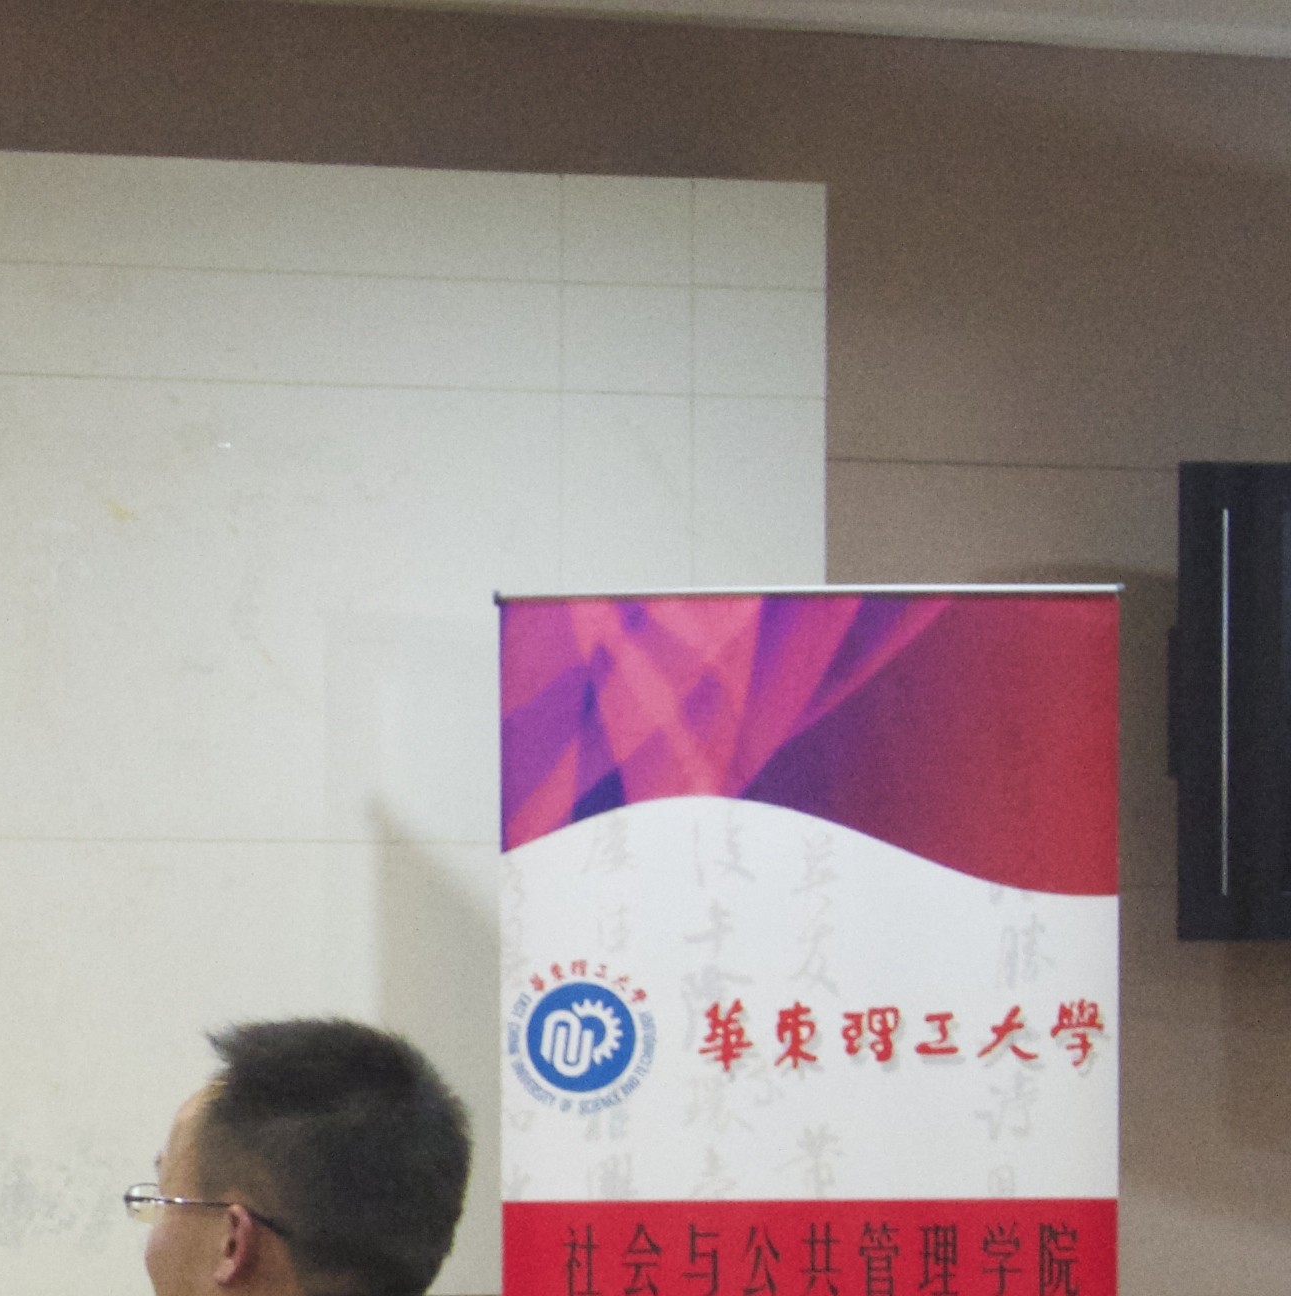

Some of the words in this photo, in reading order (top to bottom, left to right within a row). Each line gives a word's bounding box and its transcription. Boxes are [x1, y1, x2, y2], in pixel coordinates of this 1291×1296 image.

[698, 999, 1107, 1072] 華東理工大學
